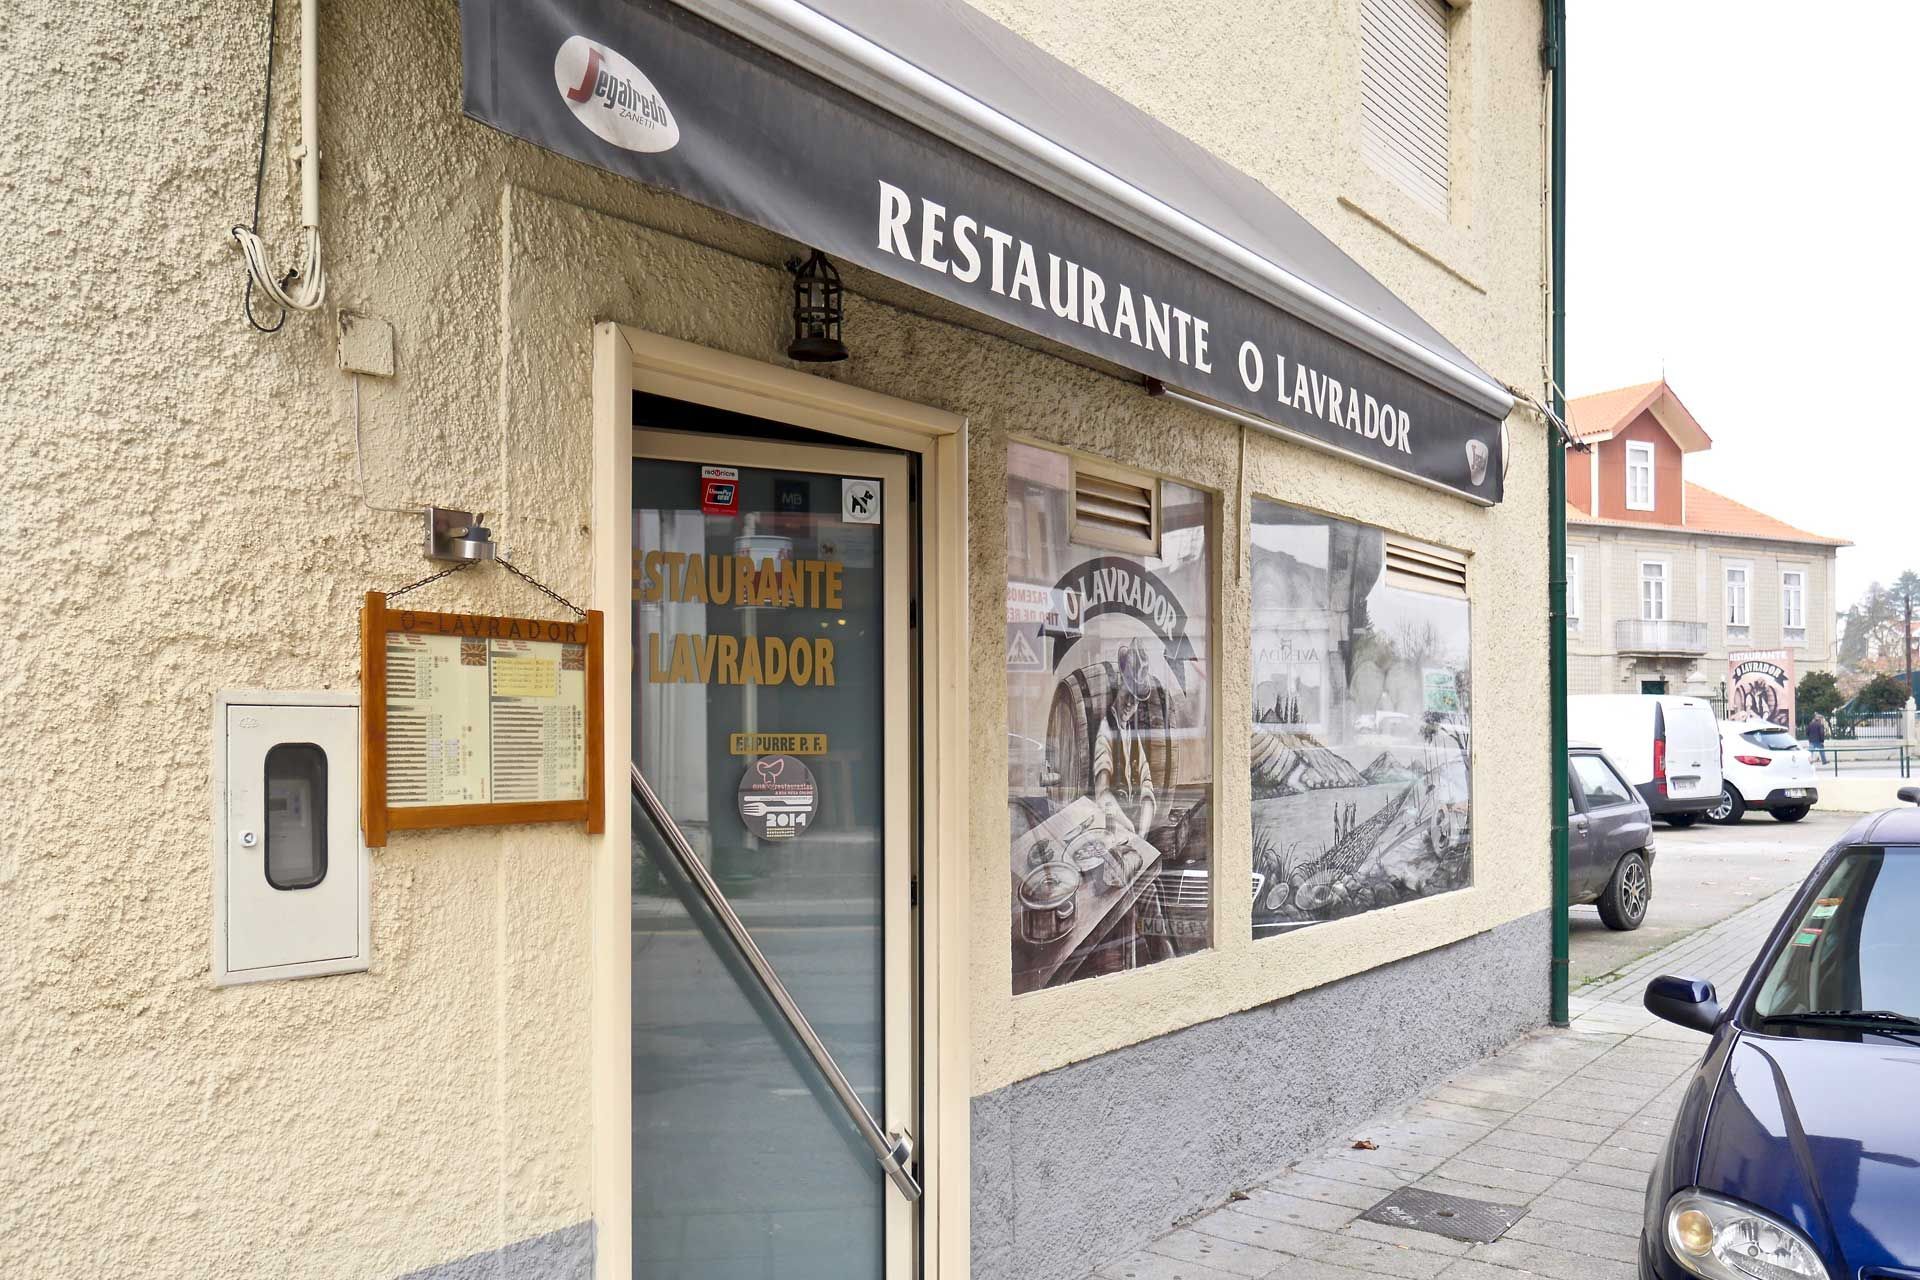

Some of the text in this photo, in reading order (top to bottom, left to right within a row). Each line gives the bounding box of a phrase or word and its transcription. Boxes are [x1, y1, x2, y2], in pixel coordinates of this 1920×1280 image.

[566, 47, 668, 127] Segafredo
[619, 108, 655, 129] ZANETTI
[878, 179, 1412, 455] RESTAURANTE O LAVRADOR
[1063, 566, 1177, 641] O LAVRADOR
[649, 632, 836, 687] LAVRADOR
[1741, 662, 1782, 678] LAVRADOR
[766, 813, 806, 827] 2014
